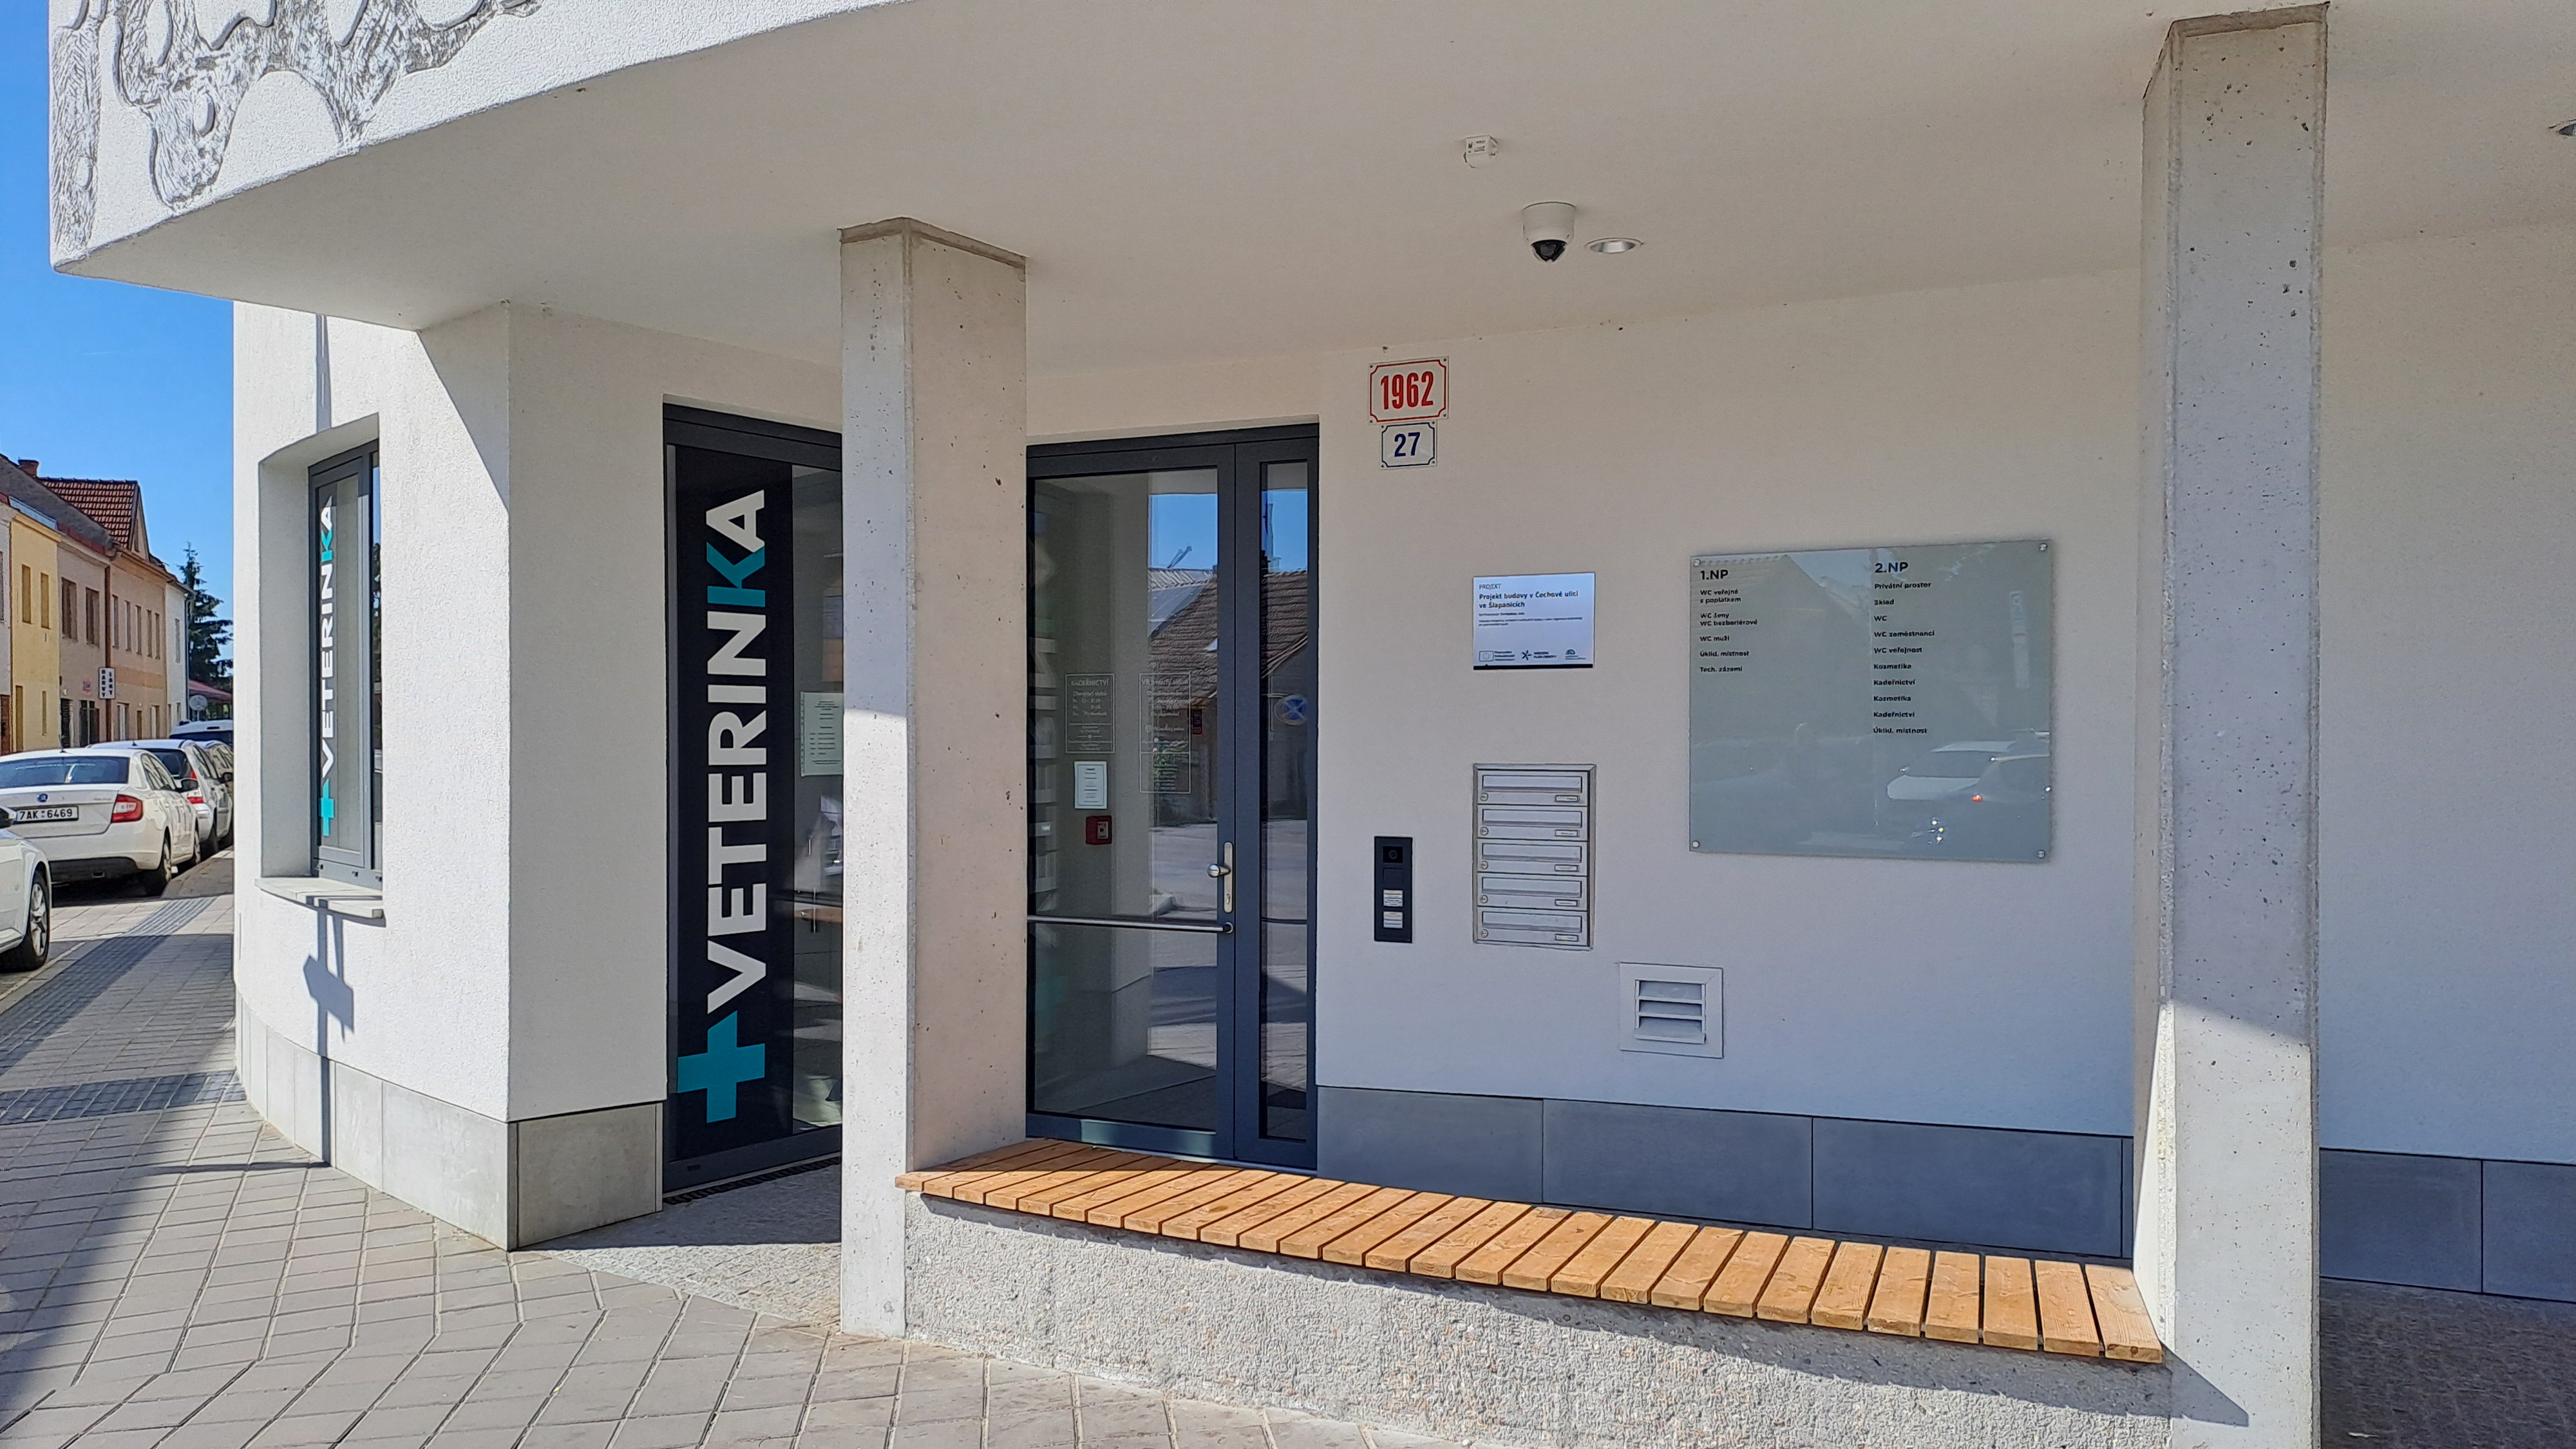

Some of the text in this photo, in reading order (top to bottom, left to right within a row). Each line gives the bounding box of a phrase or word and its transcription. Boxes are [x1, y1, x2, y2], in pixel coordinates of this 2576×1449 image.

[1380, 371, 1434, 410] 1962
[1394, 431, 1421, 457] 27
[1700, 569, 1728, 580] 1.NP
[1875, 562, 1909, 573] 2.NP
[1488, 601, 1525, 609] Šlapanicích
[321, 495, 334, 778] VETERINKA
[706, 489, 766, 1014] VETERINKA
[19, 808, 73, 820] 7AK 6469
